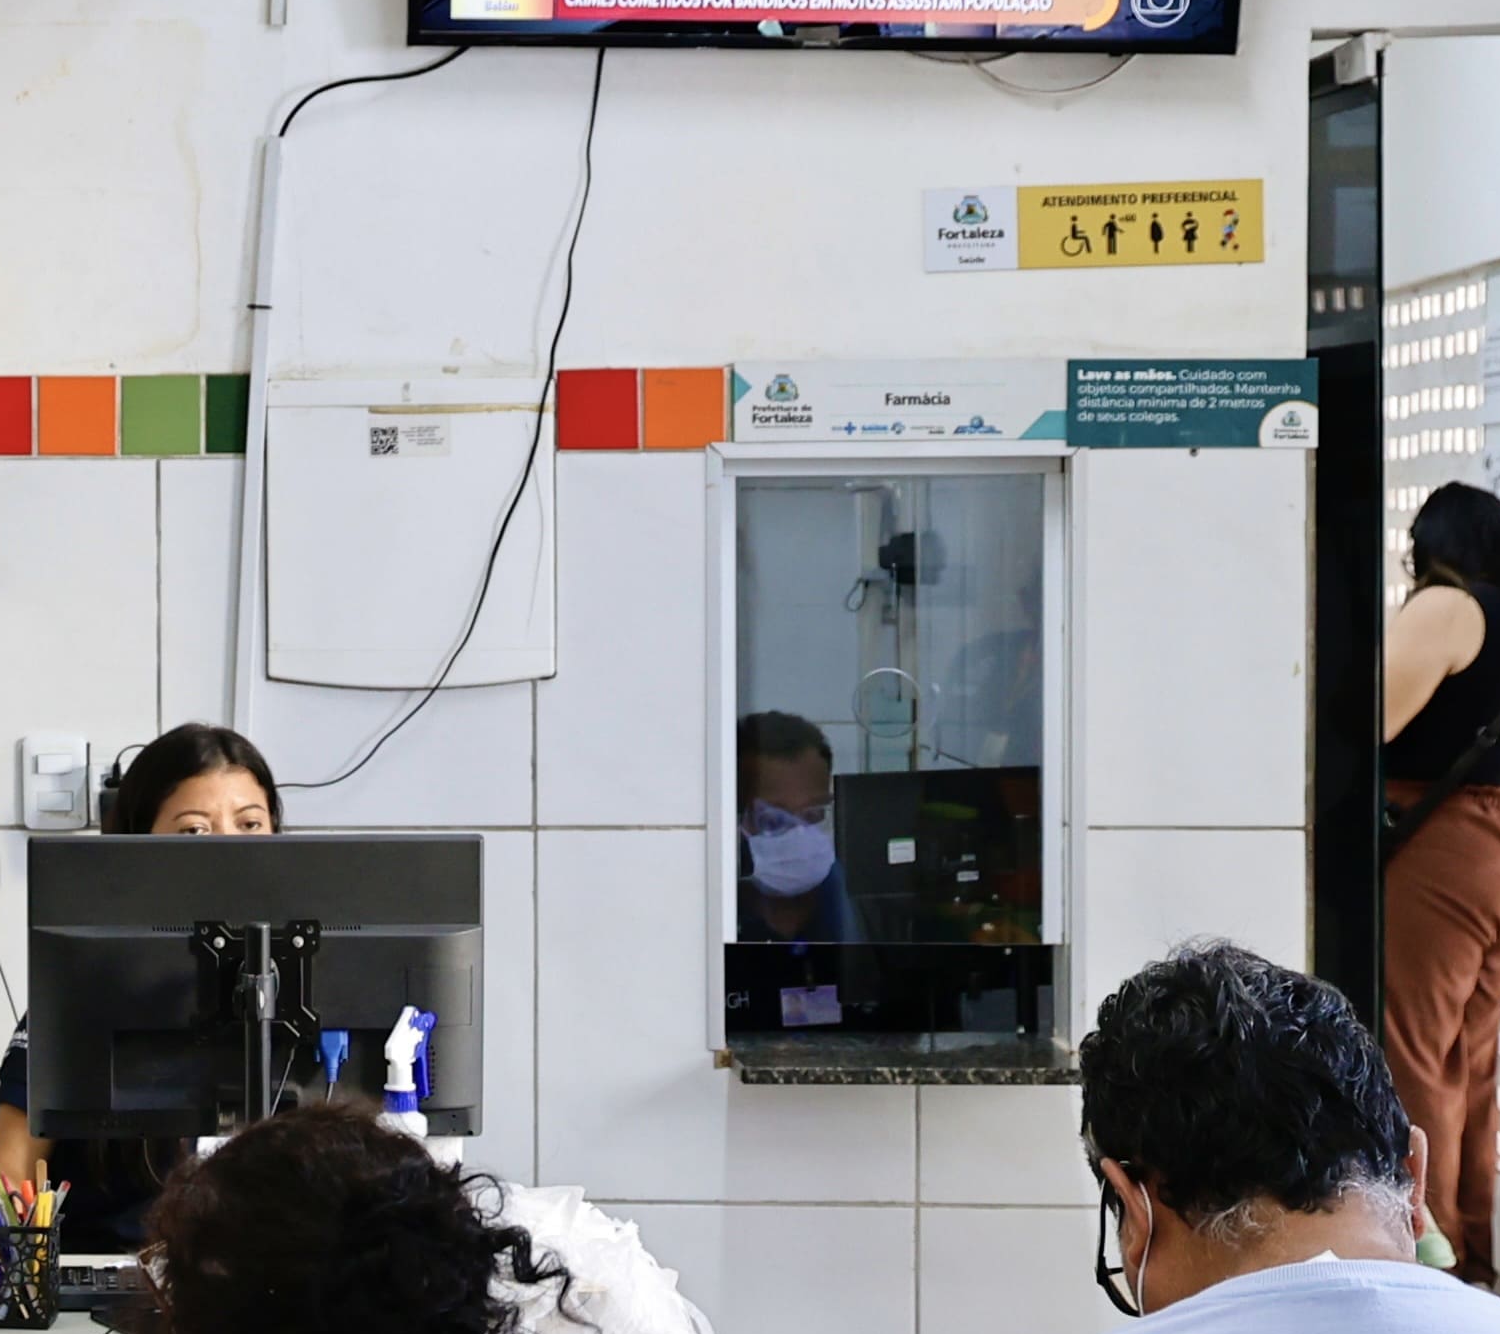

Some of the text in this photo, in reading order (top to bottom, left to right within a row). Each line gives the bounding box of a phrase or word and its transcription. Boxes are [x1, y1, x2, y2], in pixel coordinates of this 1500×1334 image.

[1042, 189, 1239, 208] ATENDIMENTO PREFERENCIAL
[937, 227, 1005, 241] Fortaleza
[1077, 369, 1267, 381] Lave as mãos. Cuidado com
[1077, 383, 1127, 397] objetos
[1234, 383, 1301, 395] Mantenha
[885, 391, 951, 406] Farmácia
[1077, 397, 1135, 409] distância
[1189, 397, 1206, 409] de
[1208, 398, 1218, 409] 2
[1218, 398, 1266, 409] metros
[751, 413, 813, 424] Fortaleza
[1077, 410, 1095, 422] de
[1097, 412, 1127, 422] seus
